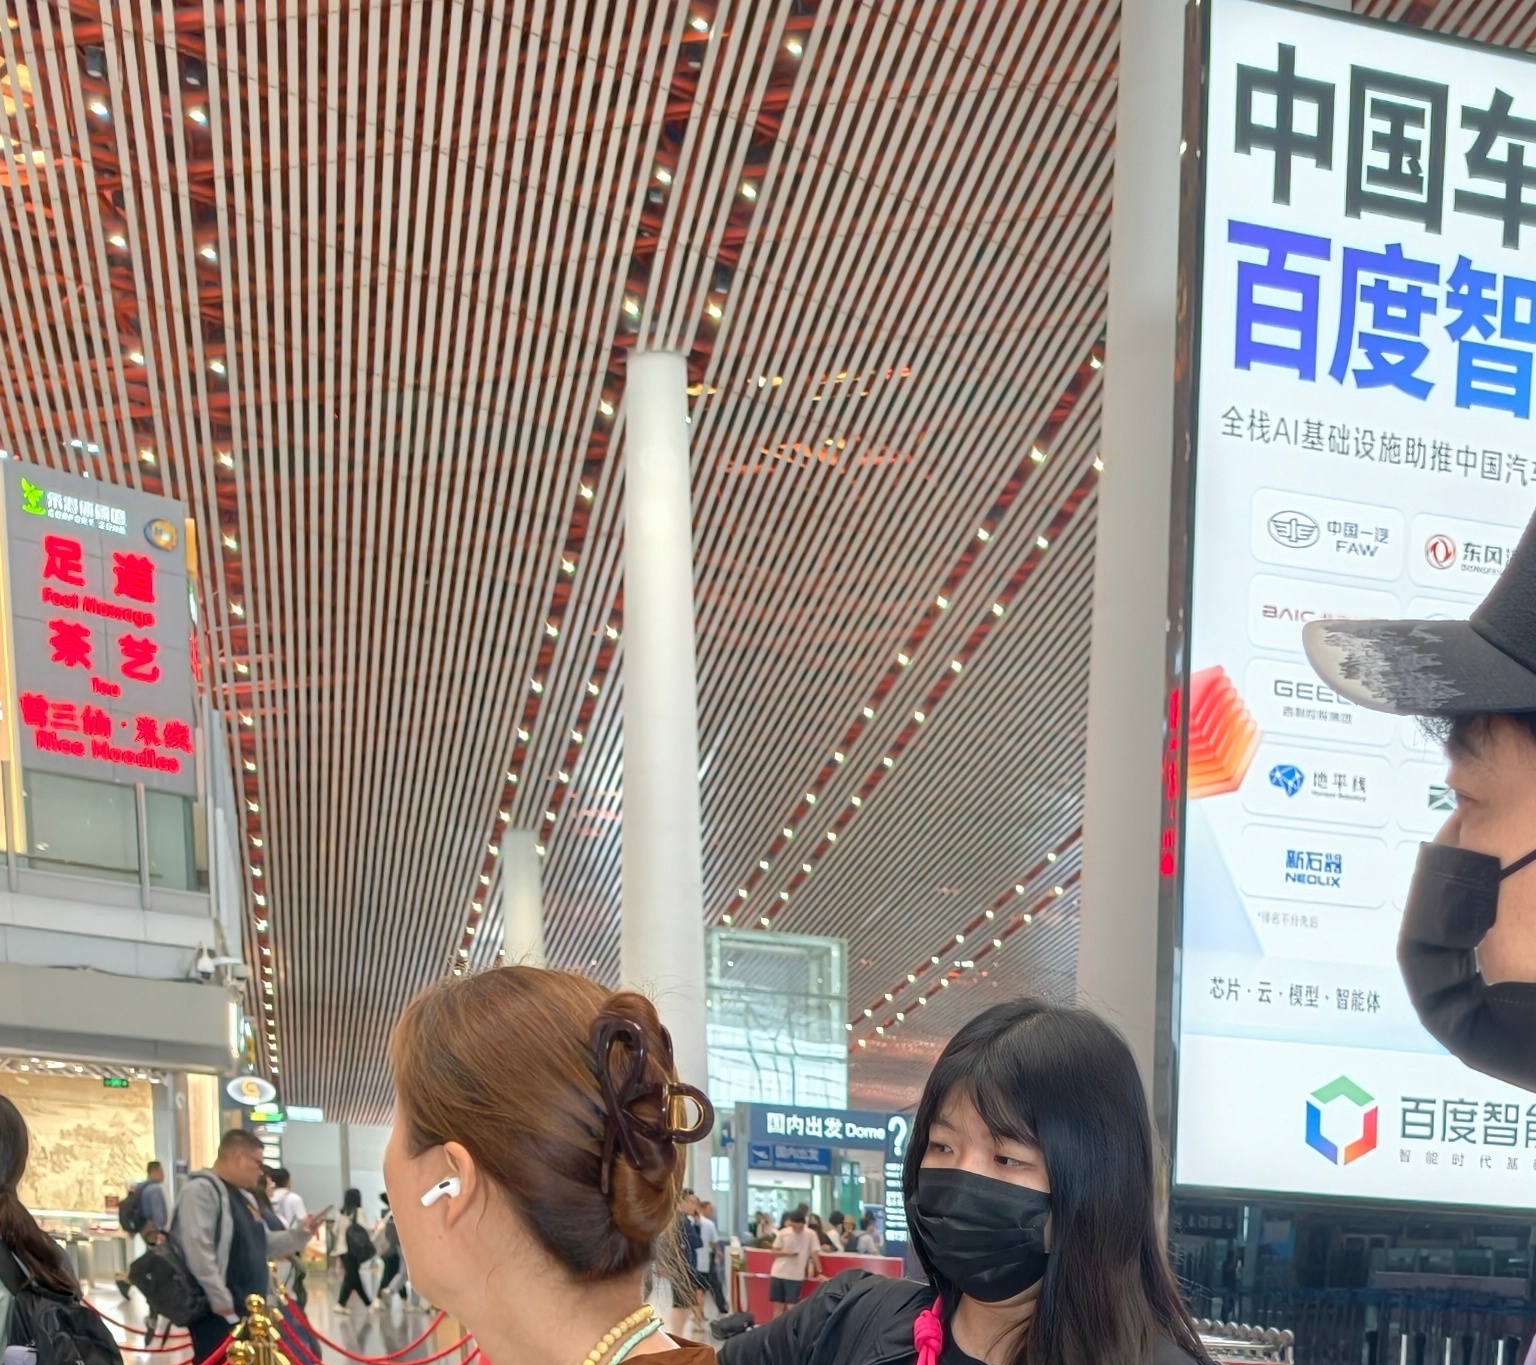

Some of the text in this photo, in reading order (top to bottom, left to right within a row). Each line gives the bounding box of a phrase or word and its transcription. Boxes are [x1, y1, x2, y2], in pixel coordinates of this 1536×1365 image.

[1326, 520, 1390, 544] 中国一汽
[1336, 540, 1380, 557] FAW
[43, 535, 156, 604] 足道
[42, 588, 79, 609] Foot
[49, 619, 160, 683] 茶艺
[91, 677, 121, 697] Tea
[1273, 679, 1353, 706] GEEL
[36, 729, 180, 774] Rice Noodles
[1286, 849, 1342, 875] 新石器
[1284, 872, 1341, 889] NEOLIX
[766, 1111, 886, 1140] 国内出发 Dome
